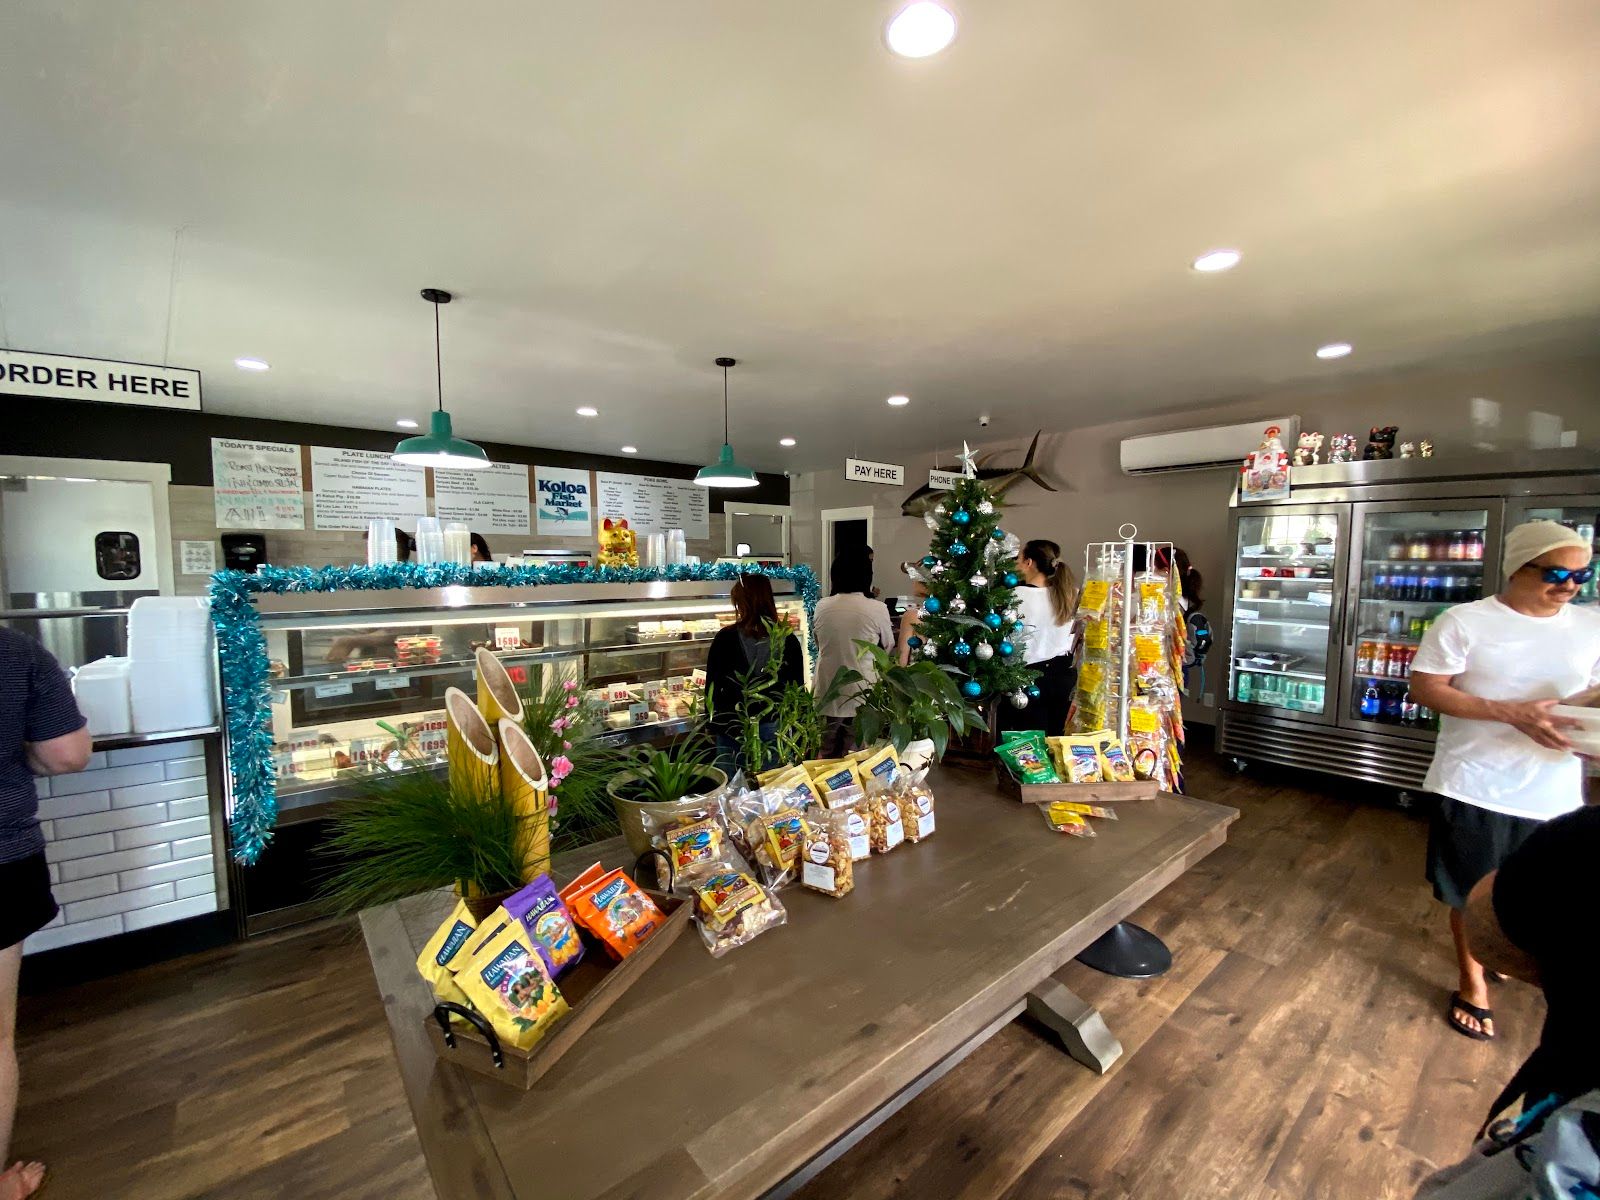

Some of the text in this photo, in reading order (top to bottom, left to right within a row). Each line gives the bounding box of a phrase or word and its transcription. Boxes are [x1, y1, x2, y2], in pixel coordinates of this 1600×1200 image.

[0, 363, 190, 398] RDER HERE
[219, 441, 295, 454] TODAY'S SPECIALS
[342, 450, 392, 460] PLATE LUNCHE
[854, 465, 897, 480] PAY HERE
[930, 474, 951, 485] PHONE
[538, 479, 588, 495] Koloa
[544, 498, 583, 508] Market
[552, 492, 576, 501] Fish
[438, 925, 468, 965] HAWAIIAN
[484, 945, 523, 981] HAWAIIAN
